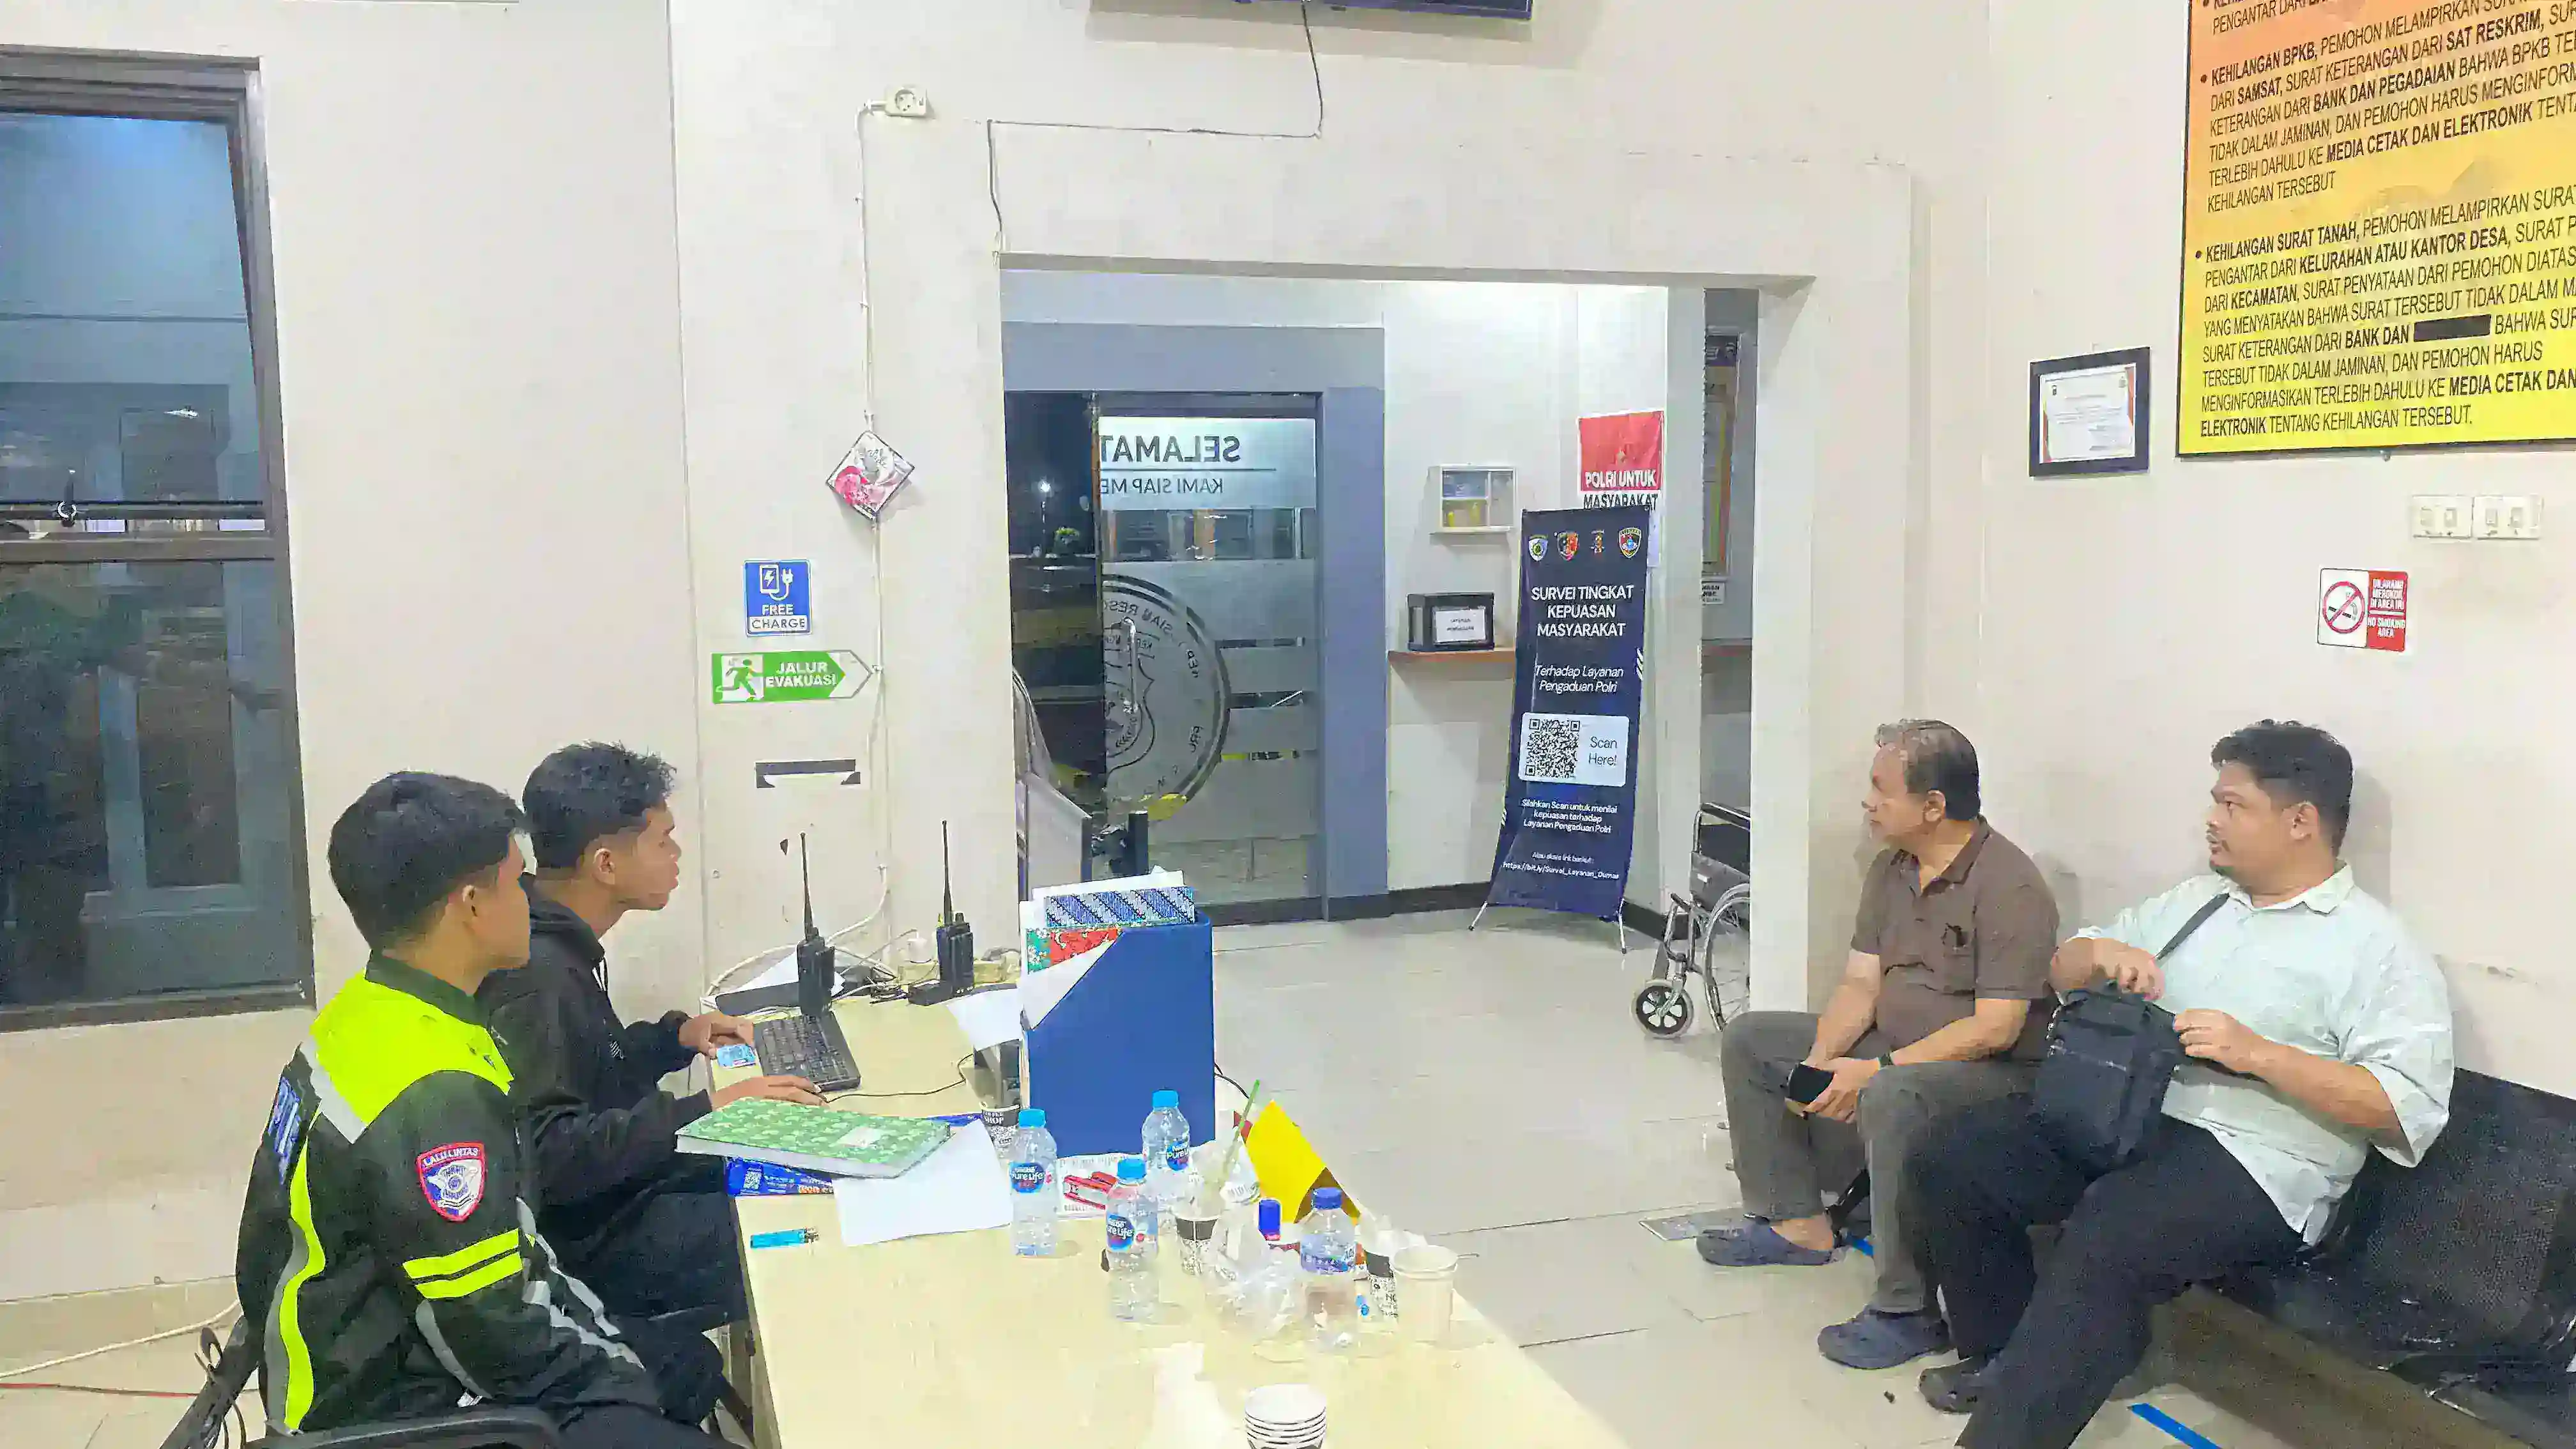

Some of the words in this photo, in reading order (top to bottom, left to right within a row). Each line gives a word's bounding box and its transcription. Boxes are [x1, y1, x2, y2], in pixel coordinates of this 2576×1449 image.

[2213, 3, 2276, 34] PENGANTAR
[2212, 50, 2280, 86] KEHILANGAN
[2283, 42, 2317, 66] BPKB,
[2320, 22, 2382, 55] PEMOHON
[2386, 0, 2480, 39] MELAMPIRKAN
[2211, 91, 2235, 111] DARI
[2237, 77, 2282, 104] SAMSAT,
[2286, 66, 2324, 91] SURAT
[2326, 43, 2407, 82] KETERANGAN
[2412, 34, 2442, 61] DARI
[2446, 26, 2472, 51] SAT
[2476, 8, 2544, 44] RESKRIM,
[2211, 103, 2281, 137] KETERANGAN
[2285, 95, 2310, 119] DARI
[2313, 86, 2347, 112] BANK
[2350, 80, 2376, 103] DAN
[2379, 59, 2455, 96] PEGADAIAN
[2459, 47, 2508, 78] BAHWA
[2512, 36, 2550, 66] BPKB
[2210, 139, 2239, 162] TIDAK
[2242, 130, 2278, 155] DALAM
[2281, 119, 2331, 146] JAMINAN,
[2336, 111, 2361, 134] DAN
[2365, 95, 2428, 128] PEMOHON
[2431, 84, 2478, 112] HARUS
[2209, 160, 2258, 187] TERLEBIH
[2262, 151, 2305, 176] DAHULU
[2308, 146, 2324, 166] KE
[2326, 139, 2365, 162] MEDIA
[2367, 128, 2408, 153] CETAK
[2412, 121, 2439, 146] DAN
[2444, 101, 2533, 138] ELEKTRONIK
[2207, 181, 2273, 213] KEHILANGAN
[2276, 171, 2336, 199] TERSEBUT
[2206, 236, 2274, 263] KEHILANGAN
[2277, 228, 2314, 251] SURAT
[2318, 221, 2359, 245] TANAH,
[2363, 208, 2427, 238] PEMOHON
[2430, 192, 2529, 227] MELAMPIRKAN
[2205, 262, 2267, 288] PENGANTAR
[2271, 258, 2296, 279] DARI
[2299, 247, 2372, 273] KELURAHAN
[2375, 239, 2407, 263] ATAU
[2411, 231, 2466, 259] KANTOR
[2470, 226, 2511, 250] DESA,
[2515, 217, 2564, 243] SURAT
[2204, 295, 2228, 313] DARI
[2231, 284, 2299, 309] KECAMATAN,
[2303, 277, 2341, 300] SURAT
[2344, 267, 2414, 295] PENYATAAN
[2418, 263, 2448, 286] DARI
[2451, 253, 2523, 281] PEMOHON
[2204, 318, 2232, 339] YANG
[2234, 309, 2304, 335] MENYATAKAN
[2307, 303, 2348, 326] BAHWA
[2351, 298, 2391, 321] SURAT
[2395, 290, 2462, 316] TERSEBUT
[2465, 284, 2506, 309] TIDAK
[2509, 279, 2558, 304] DALAM
[2203, 342, 2237, 362] SURAT
[2239, 335, 2312, 359] KETERANGAN
[2315, 332, 2342, 351] DARI
[2345, 328, 2379, 348] BANK
[2383, 325, 2409, 345] DAN
[2495, 311, 2546, 335] BAHWA
[2203, 365, 2256, 388] TERSEBUT
[2258, 363, 2290, 383] TIDAK
[2292, 359, 2331, 380] DALAM
[2334, 353, 2388, 377] JAMINAN,
[2392, 351, 2419, 372] DAN
[2422, 346, 2489, 369] PEMOHON
[2494, 341, 2543, 365] HARUS
[2202, 387, 2311, 413] MENGINFORMASIKAN
[2314, 383, 2371, 405] TERLEBIH
[2373, 378, 2425, 401] DAHULU
[2428, 377, 2446, 397] KE
[2449, 374, 2492, 396] MEDIA
[2495, 371, 2542, 393] CETAK
[2547, 367, 2576, 390] DAN
[2200, 417, 2267, 438] ELEKTRONIK
[2269, 413, 2320, 434] TENTANG
[2322, 408, 2398, 431] KEHILANGAN
[2403, 404, 2472, 427] TERSEBUT.
[1584, 470, 1616, 488] POLRI
[1618, 469, 1657, 487] UNTUK
[1583, 493, 1659, 511] MASYARAKAT
[1531, 586, 1576, 601] SURVEI
[1578, 585, 1634, 600] TINGKAT
[762, 604, 794, 615] FREE
[1547, 604, 1616, 618] KEPUASAN
[751, 618, 806, 629] CHARGE
[1537, 623, 1626, 636] MASYARAKAT
[766, 674, 837, 688] EVAKUASI
[776, 662, 828, 675] JALUR
[1535, 664, 1581, 680] Terhadap
[1582, 665, 1623, 679] Layanan
[1539, 680, 1593, 694] Pengaduan
[1595, 680, 1618, 693] Polri
[1590, 736, 1617, 749] Scan
[1588, 753, 1617, 766] Here!
[1522, 799, 1551, 809] Silahkan
[1551, 801, 1569, 810] Scan
[1523, 819, 1554, 829] Layanan
